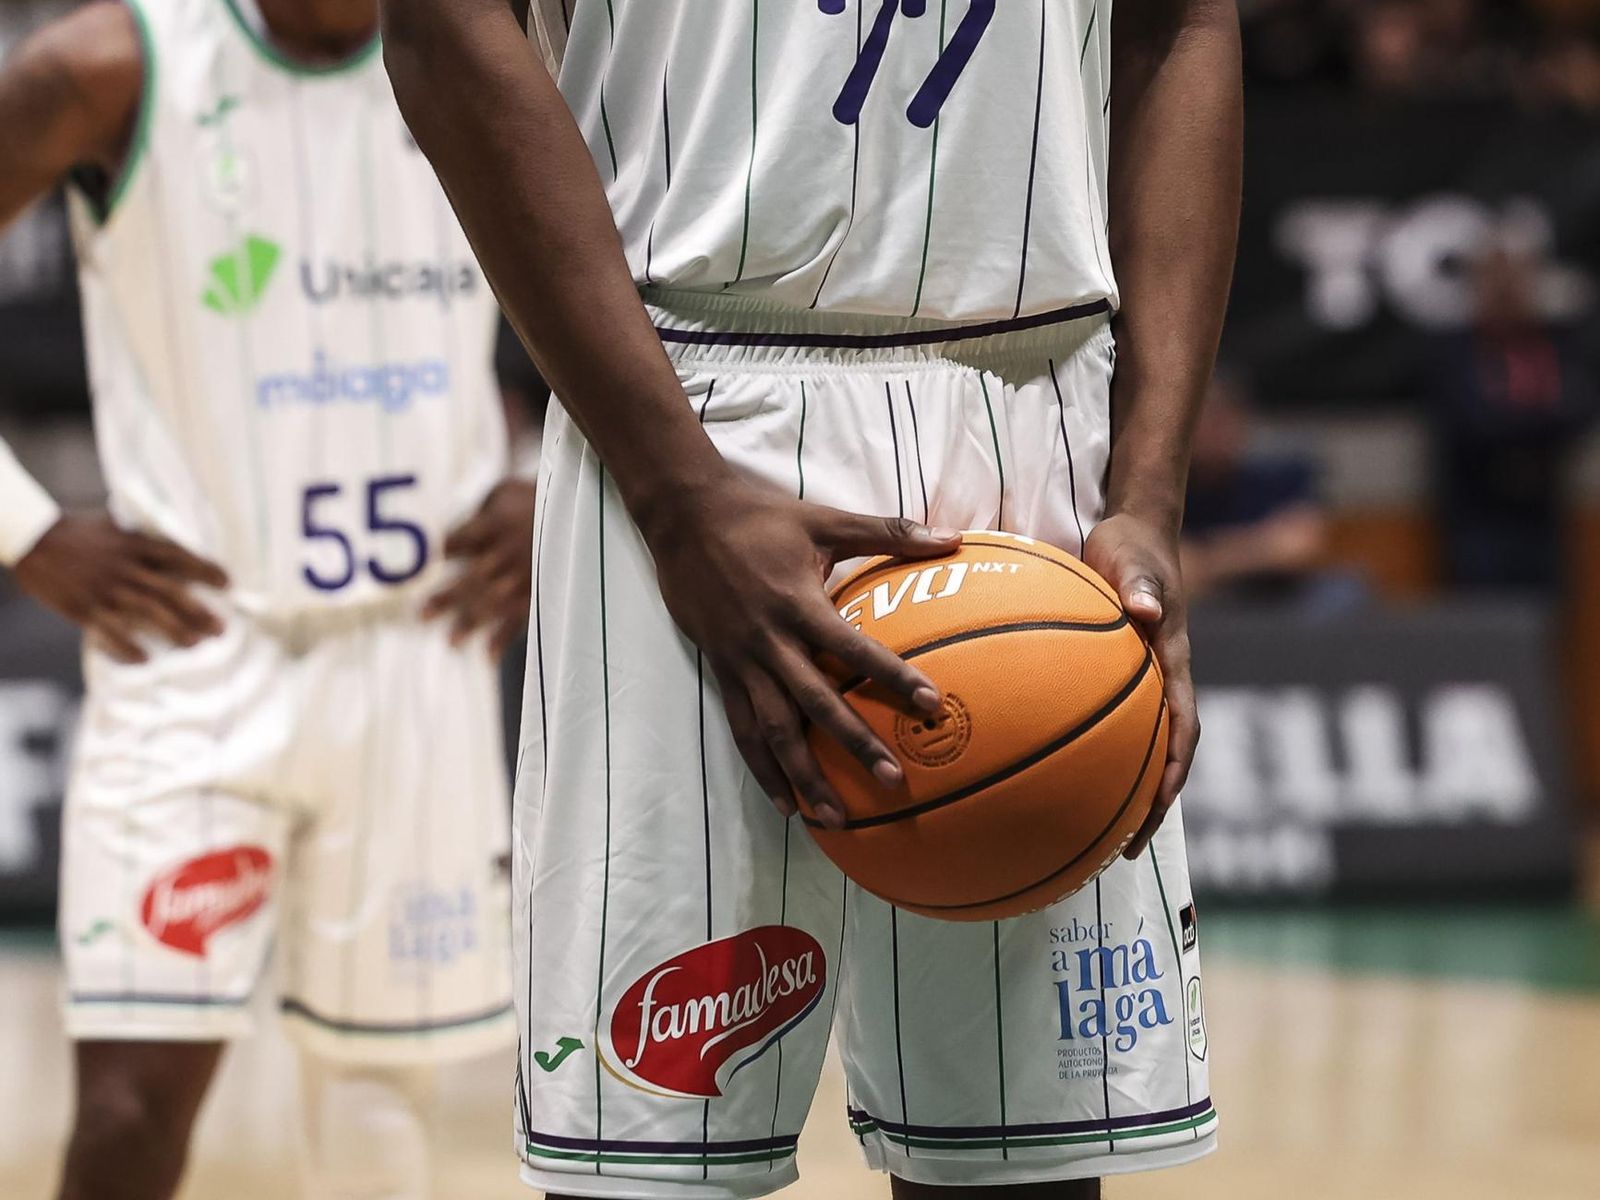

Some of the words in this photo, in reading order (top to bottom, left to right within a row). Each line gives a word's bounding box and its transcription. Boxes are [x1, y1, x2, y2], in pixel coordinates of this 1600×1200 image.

[303, 474, 429, 591] 55
[972, 562, 1023, 574] NXT
[1049, 917, 1113, 944] sabor
[1052, 950, 1070, 972] a
[625, 941, 816, 1069] famadesa
[1053, 980, 1175, 1052] laga
[1057, 1046, 1102, 1057] PRODUCTOS
